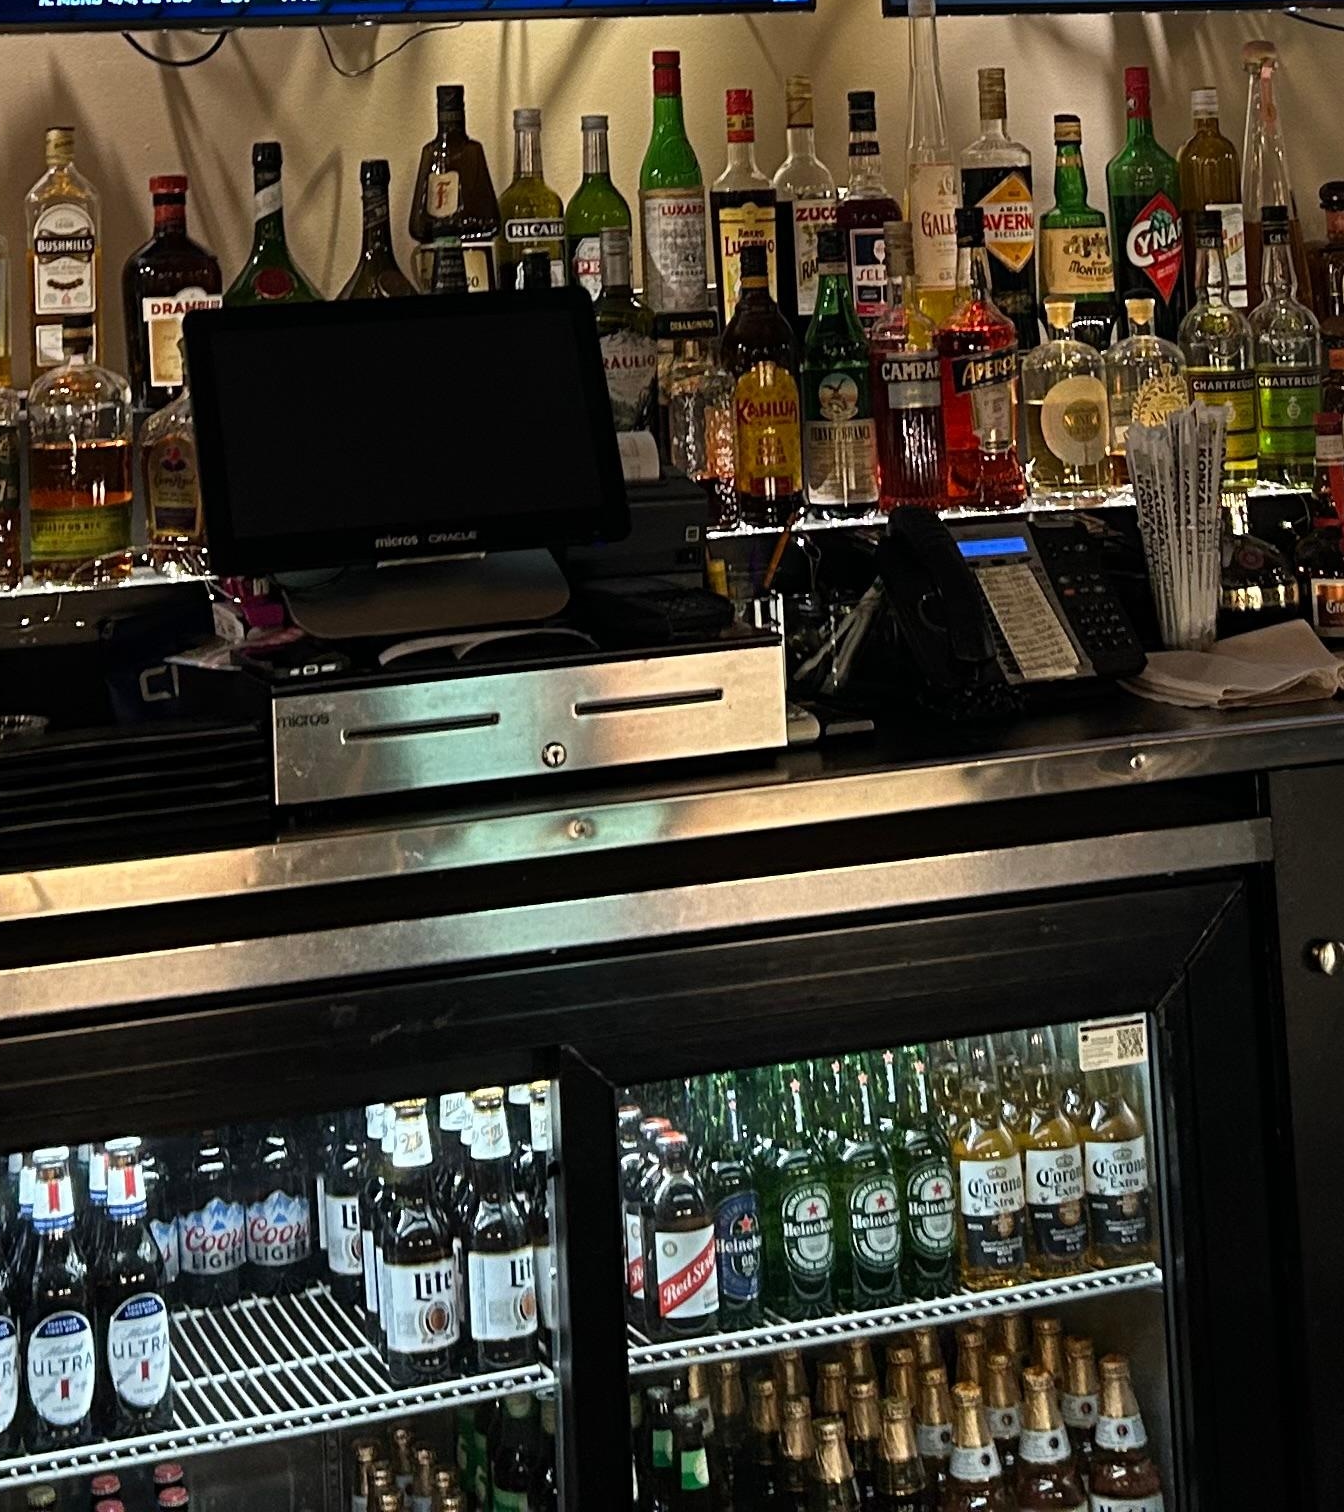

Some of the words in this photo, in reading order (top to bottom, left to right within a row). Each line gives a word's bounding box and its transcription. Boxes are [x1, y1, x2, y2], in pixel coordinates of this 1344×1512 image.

[36, 238, 94, 254] BUSHMILLS
[375, 534, 418, 549] micros
[276, 711, 330, 729] micros
[1110, 1178, 1139, 1189] Extra
[984, 1196, 1015, 1209] Extra
[414, 1269, 453, 1301] Lite
[112, 1332, 168, 1359] ULTRA
[32, 1352, 93, 1377] ULTRA
